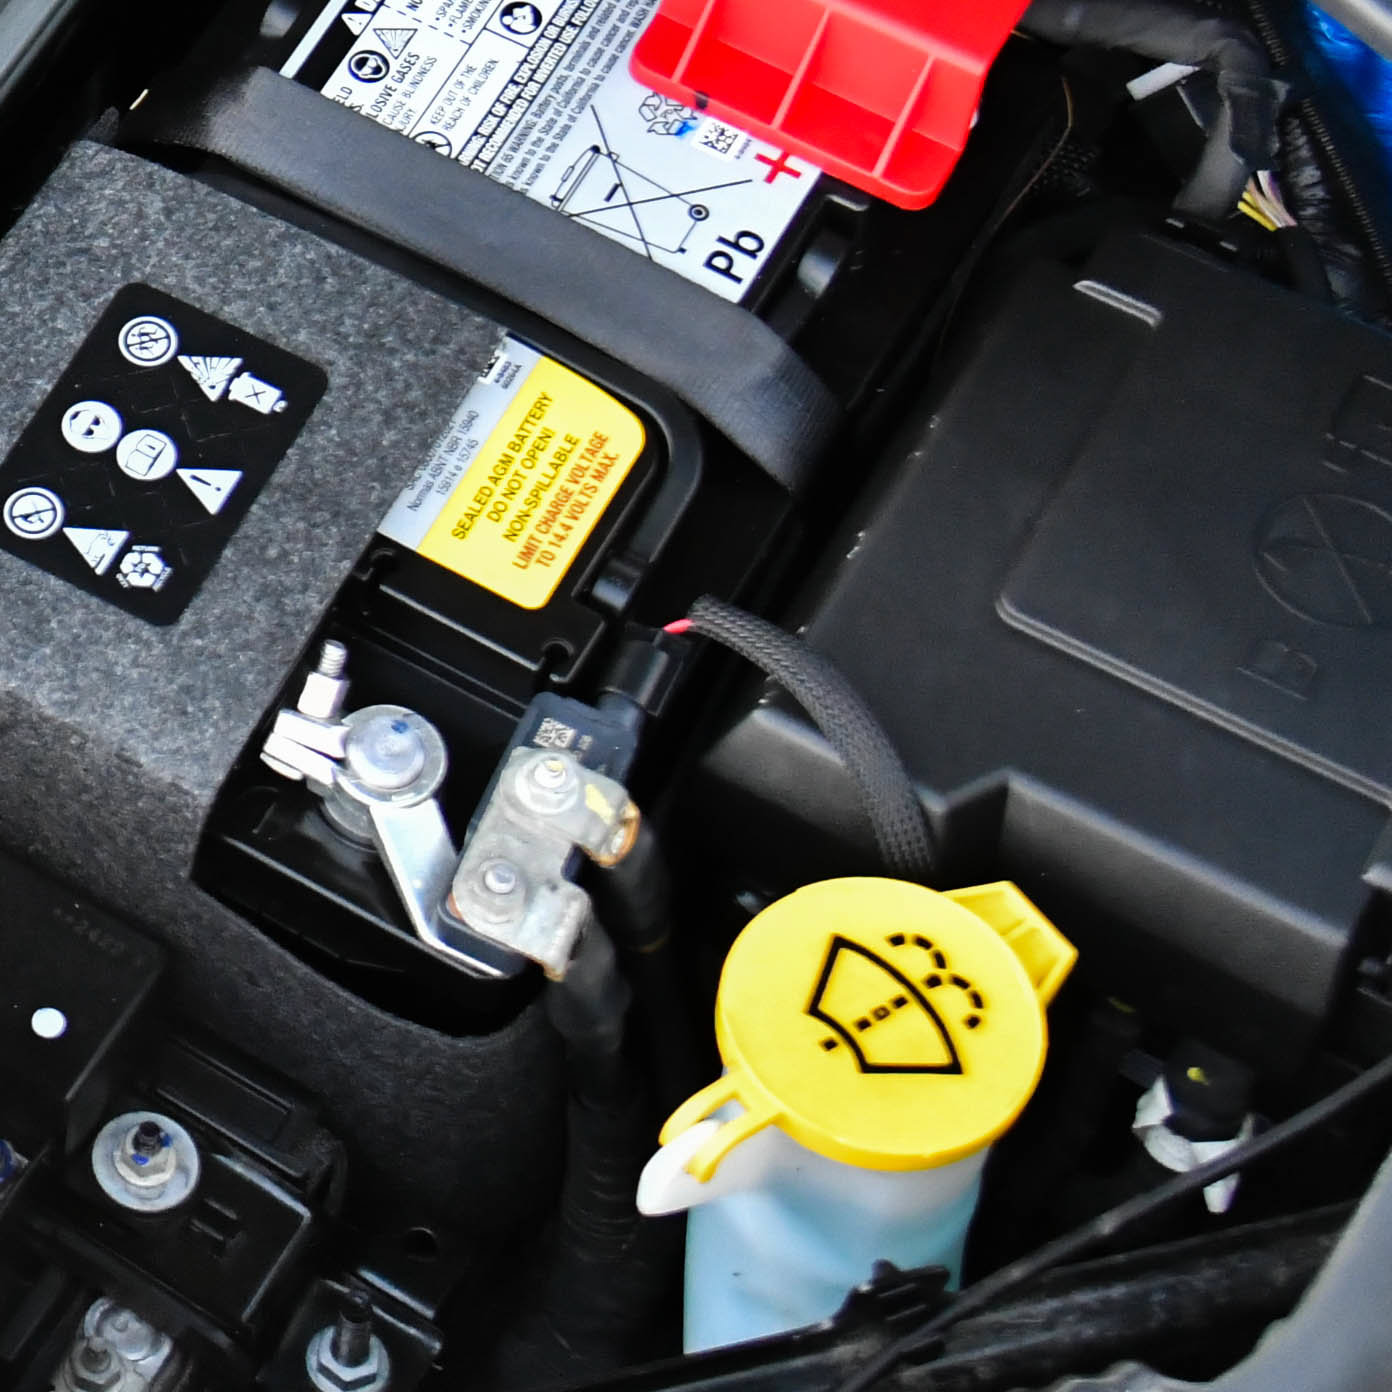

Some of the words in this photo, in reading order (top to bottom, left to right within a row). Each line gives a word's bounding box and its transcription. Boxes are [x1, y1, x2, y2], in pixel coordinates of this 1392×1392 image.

[583, 25, 601, 40] and
[591, 1, 617, 27] related
[389, 50, 421, 83] GASES
[399, 54, 438, 99] BLINDNESS
[459, 63, 477, 79] THE
[476, 113, 501, 136] RISK
[489, 101, 509, 117] OF
[511, 36, 554, 84] EXPLOSION
[542, 23, 562, 39] OR
[530, 41, 568, 83] INVERTED
[441, 89, 459, 106] OUT
[452, 78, 467, 90] OF
[519, 80, 542, 100] FOR
[427, 105, 448, 125] KEEP
[440, 105, 466, 132] REACH
[458, 94, 473, 106] OF
[529, 92, 558, 120] Battery
[476, 97, 531, 162] RECOMMENDED
[697, 222, 771, 284] Pb
[449, 483, 495, 540] SEALED
[484, 451, 515, 486] AGM
[505, 390, 555, 453] BATTERY
[484, 498, 509, 523] DO
[499, 469, 528, 501] NOT
[518, 425, 556, 471] OPEN!
[500, 432, 580, 543] NON-SPILLABLE
[511, 532, 544, 570] LIMIT
[532, 484, 575, 536] CHARGE
[563, 430, 609, 487] VOLTAGE
[534, 548, 556, 569] TO
[546, 520, 573, 550] 14.4
[563, 480, 599, 523] VOLTS
[588, 448, 619, 483] MAX.
